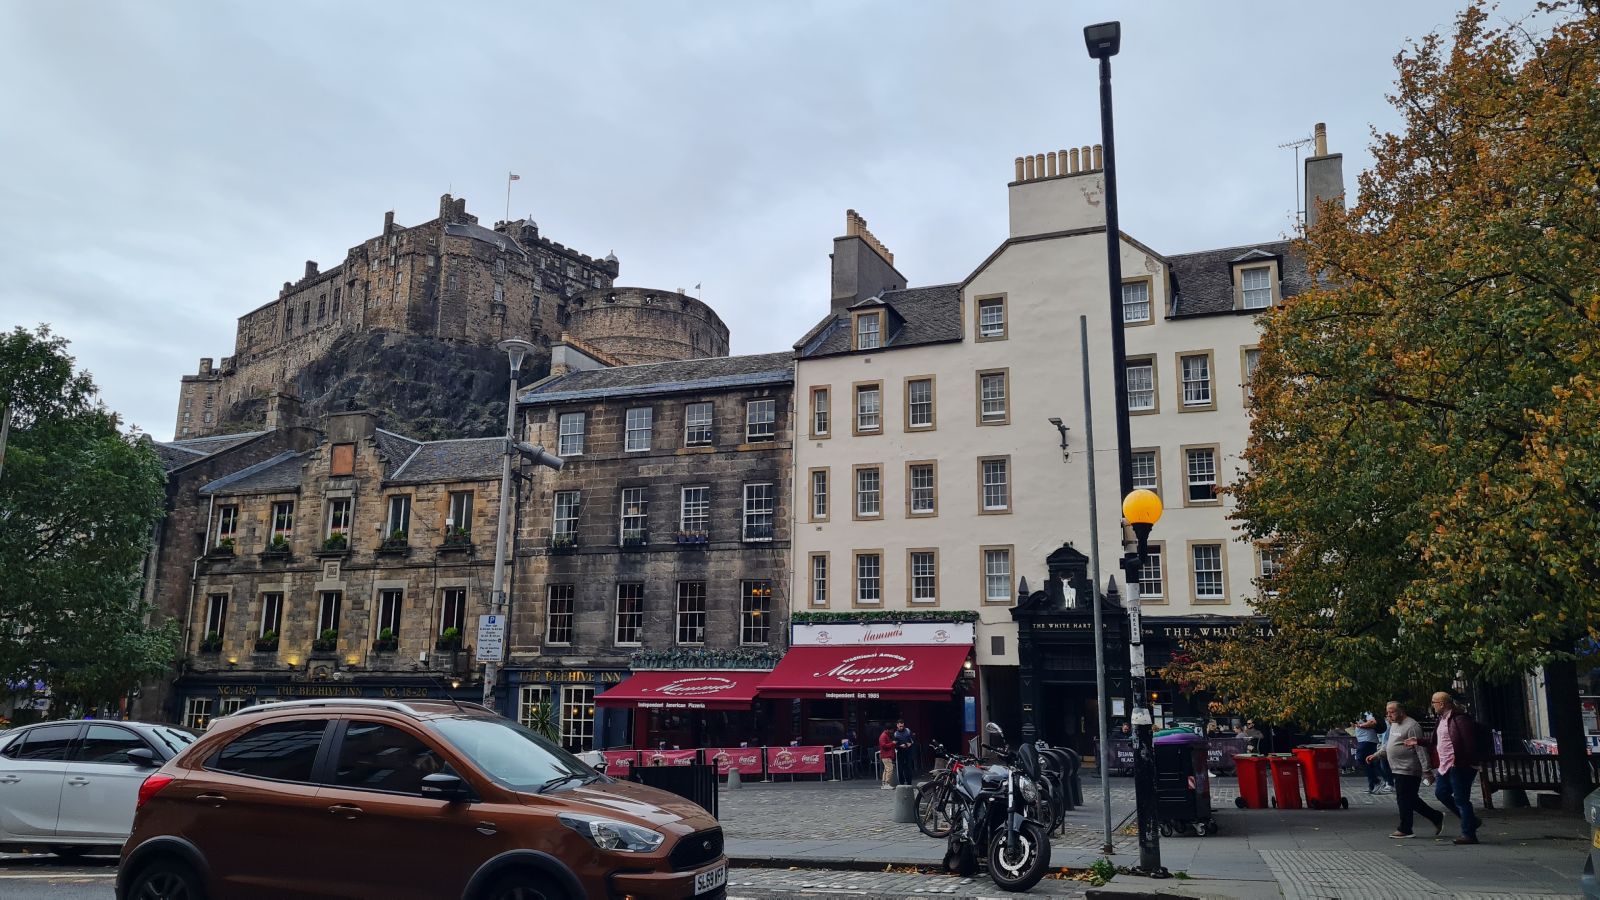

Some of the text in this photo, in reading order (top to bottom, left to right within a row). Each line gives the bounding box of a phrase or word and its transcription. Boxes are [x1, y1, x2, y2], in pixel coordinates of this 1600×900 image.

[1164, 627, 1191, 637] THE
[1200, 627, 1241, 637] WHIT
[813, 659, 914, 677] Mamma's
[520, 671, 621, 682] THE BEEHIVE INN
[277, 685, 362, 697] THE BEEHIVE INN
